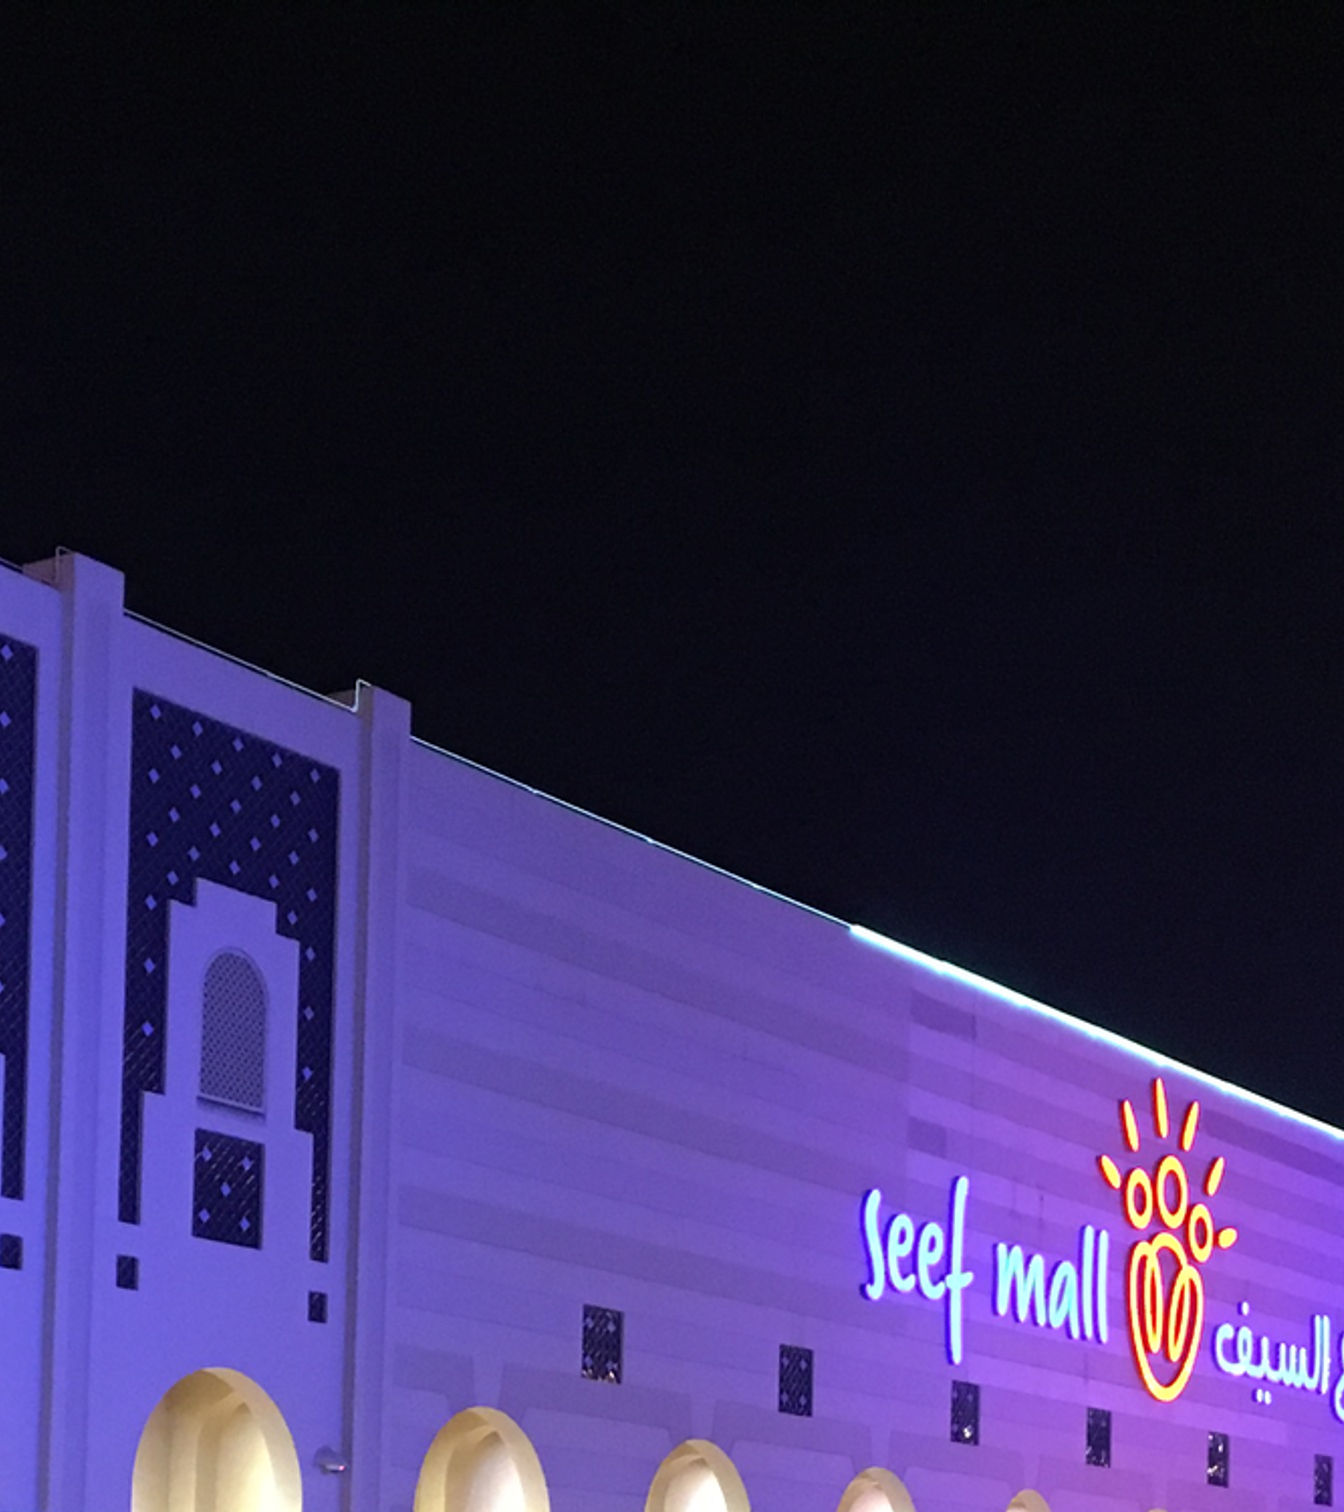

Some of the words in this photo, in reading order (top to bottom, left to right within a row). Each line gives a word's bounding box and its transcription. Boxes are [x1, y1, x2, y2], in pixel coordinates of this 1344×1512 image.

[863, 1175, 974, 1366] Seef
[995, 1224, 1109, 1344] mall
[1214, 1301, 1331, 1404] السيف
